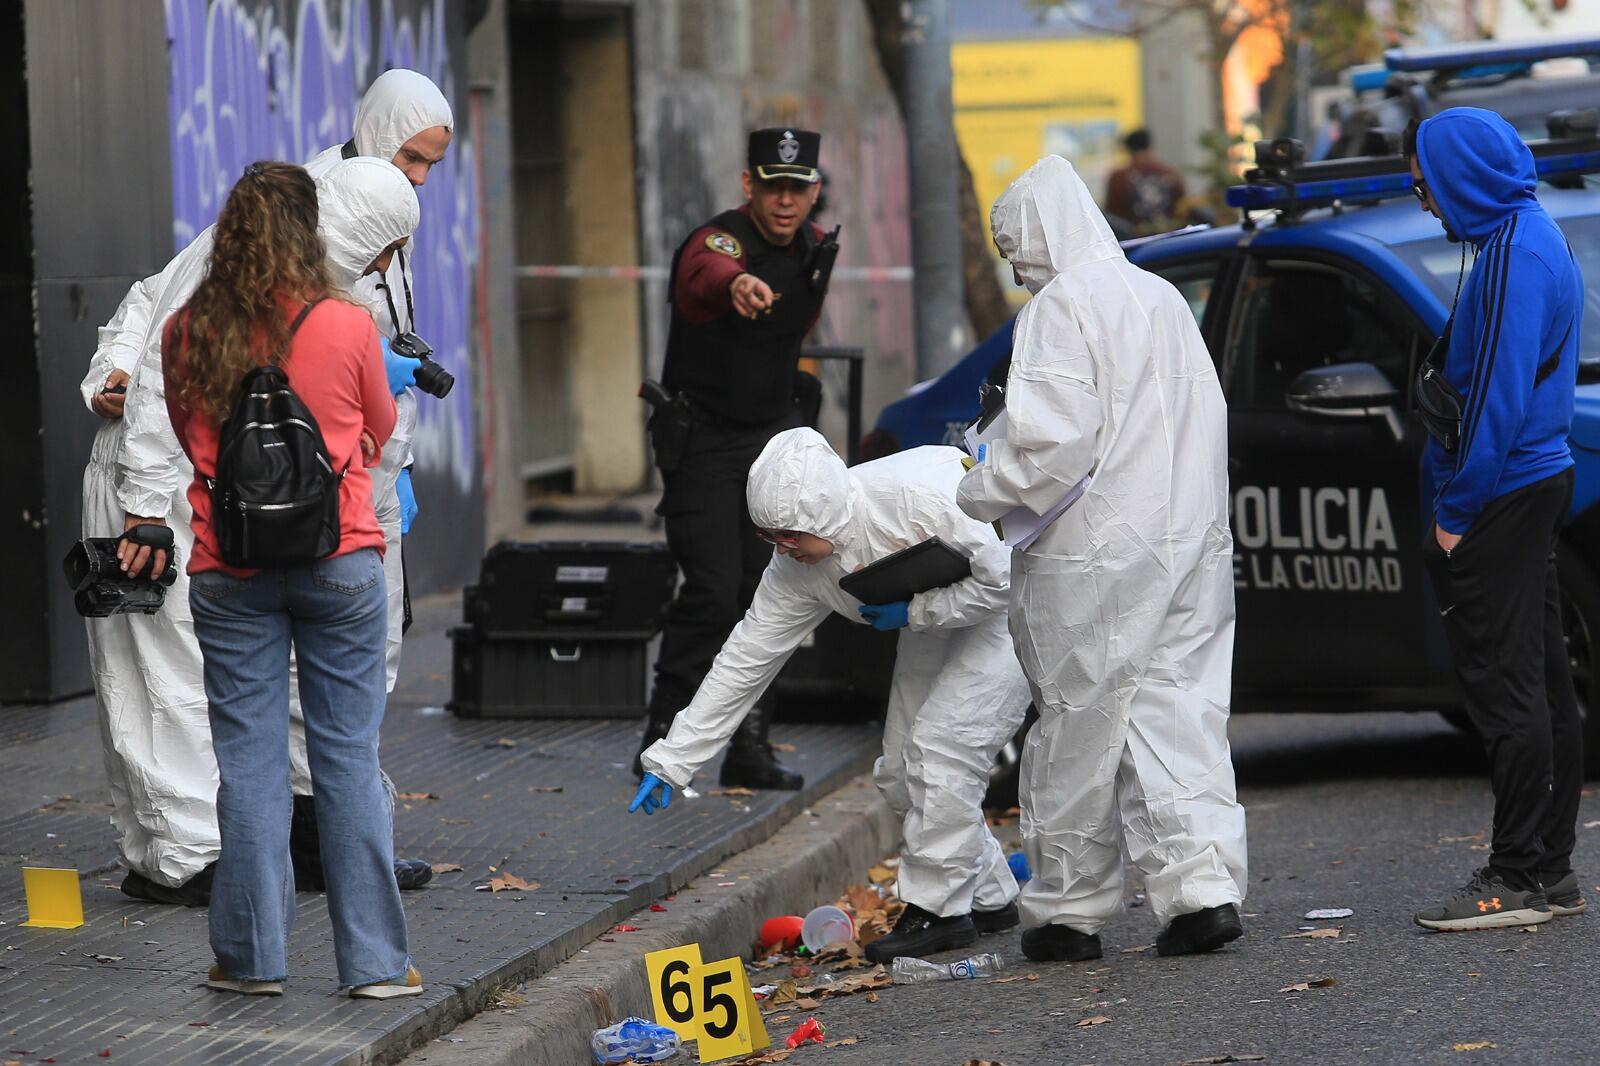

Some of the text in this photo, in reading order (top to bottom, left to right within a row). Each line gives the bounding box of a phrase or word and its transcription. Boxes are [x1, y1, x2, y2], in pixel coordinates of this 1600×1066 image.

[1229, 485, 1398, 551] OLICIA
[1233, 554, 1402, 593] E LA CIUDAD
[660, 960, 695, 1024] 6
[703, 971, 738, 1039] 5
